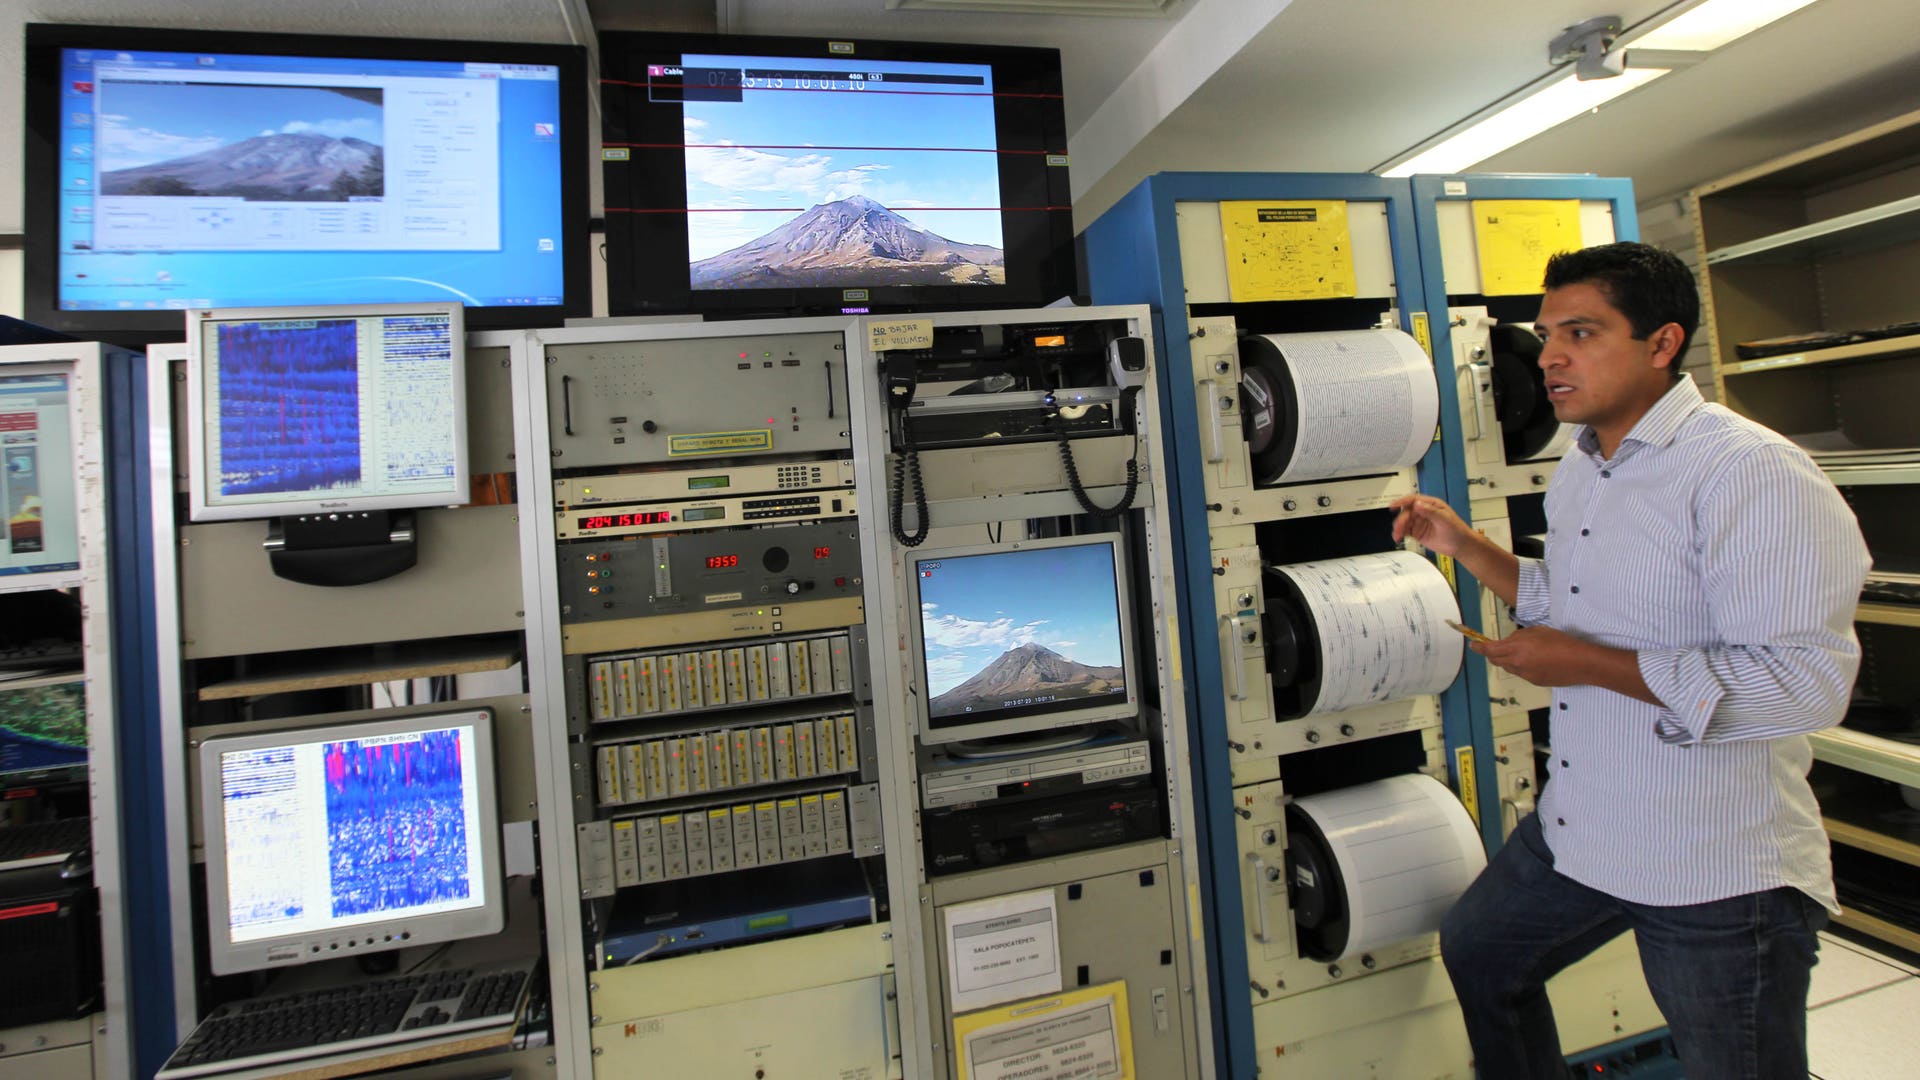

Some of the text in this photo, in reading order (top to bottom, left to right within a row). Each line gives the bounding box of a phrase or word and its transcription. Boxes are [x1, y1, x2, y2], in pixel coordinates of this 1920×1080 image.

[663, 67, 684, 75] Cable
[873, 324, 917, 335] NO BAJAR
[873, 336, 929, 346] EL VOLUMEN
[586, 516, 612, 529] 204
[619, 514, 631, 526] 15
[634, 513, 651, 525] 01
[710, 555, 737, 568] 1359
[973, 946, 989, 954] SALA
